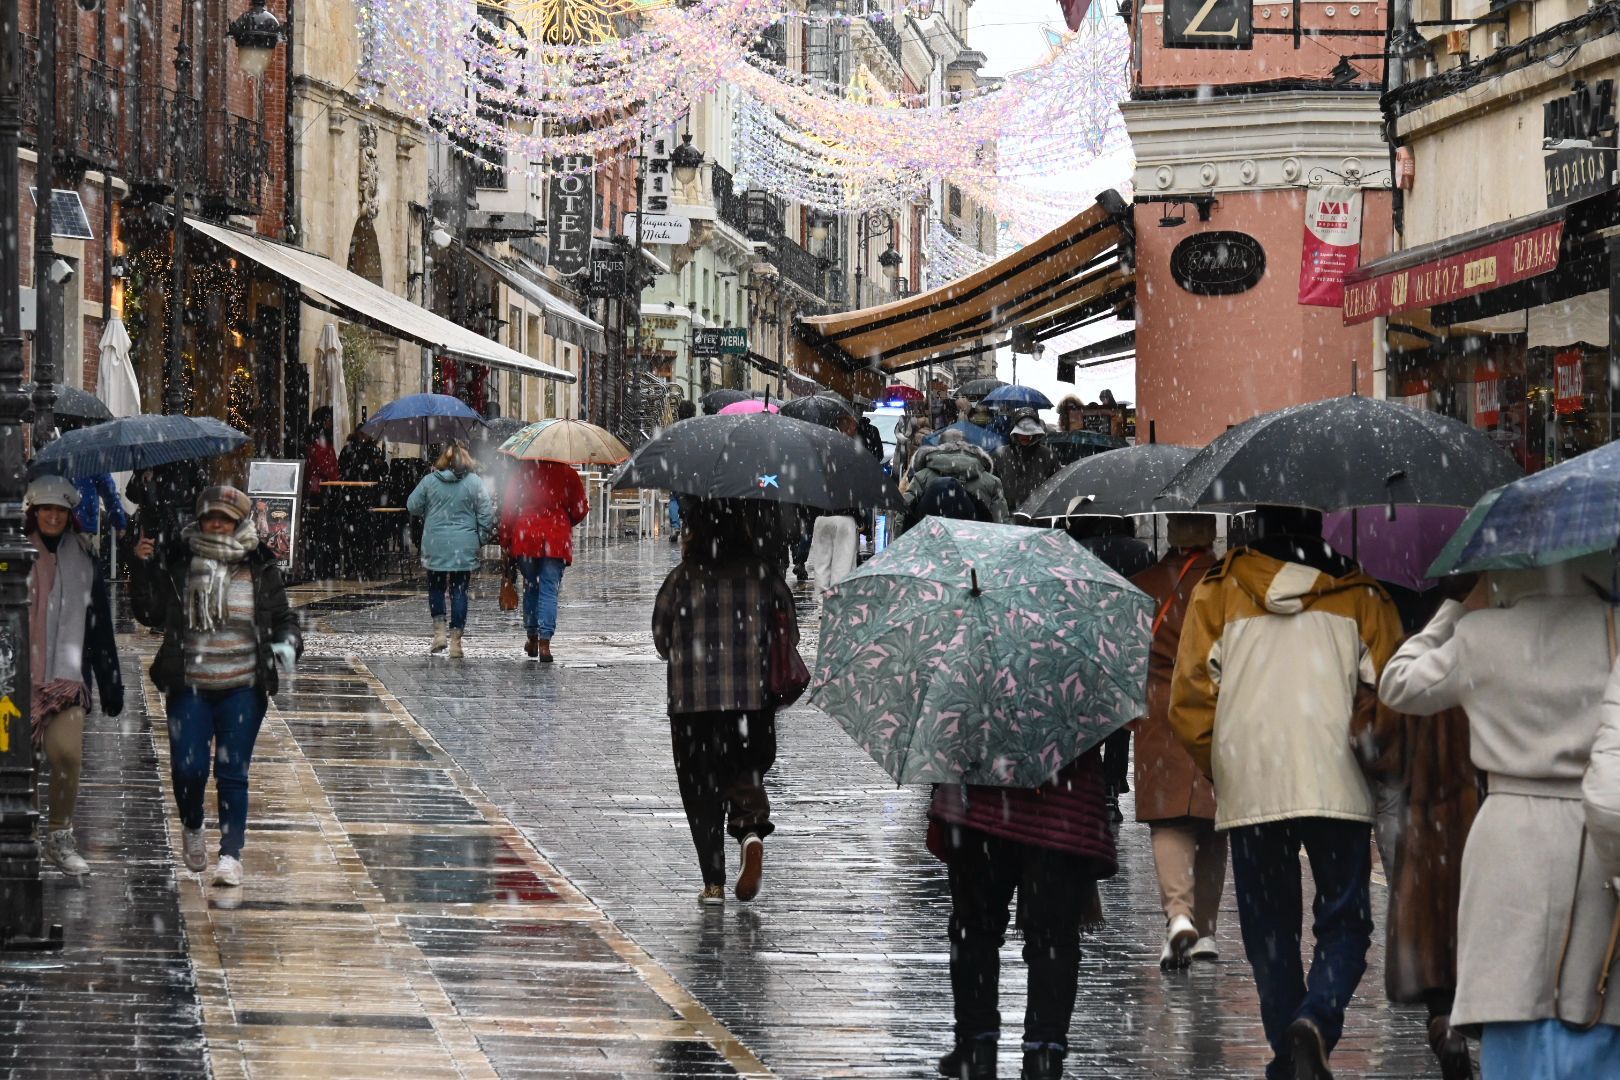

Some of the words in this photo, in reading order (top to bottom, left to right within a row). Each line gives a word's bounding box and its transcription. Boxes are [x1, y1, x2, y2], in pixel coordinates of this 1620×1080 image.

[1546, 151, 1605, 197] zapatos
[558, 156, 585, 252] HOTEL
[1512, 230, 1560, 274] REBAJAS
[1344, 282, 1378, 317] REBAJAS
[1415, 263, 1458, 302] MUÑOZ
[720, 335, 746, 348] OYERIA
